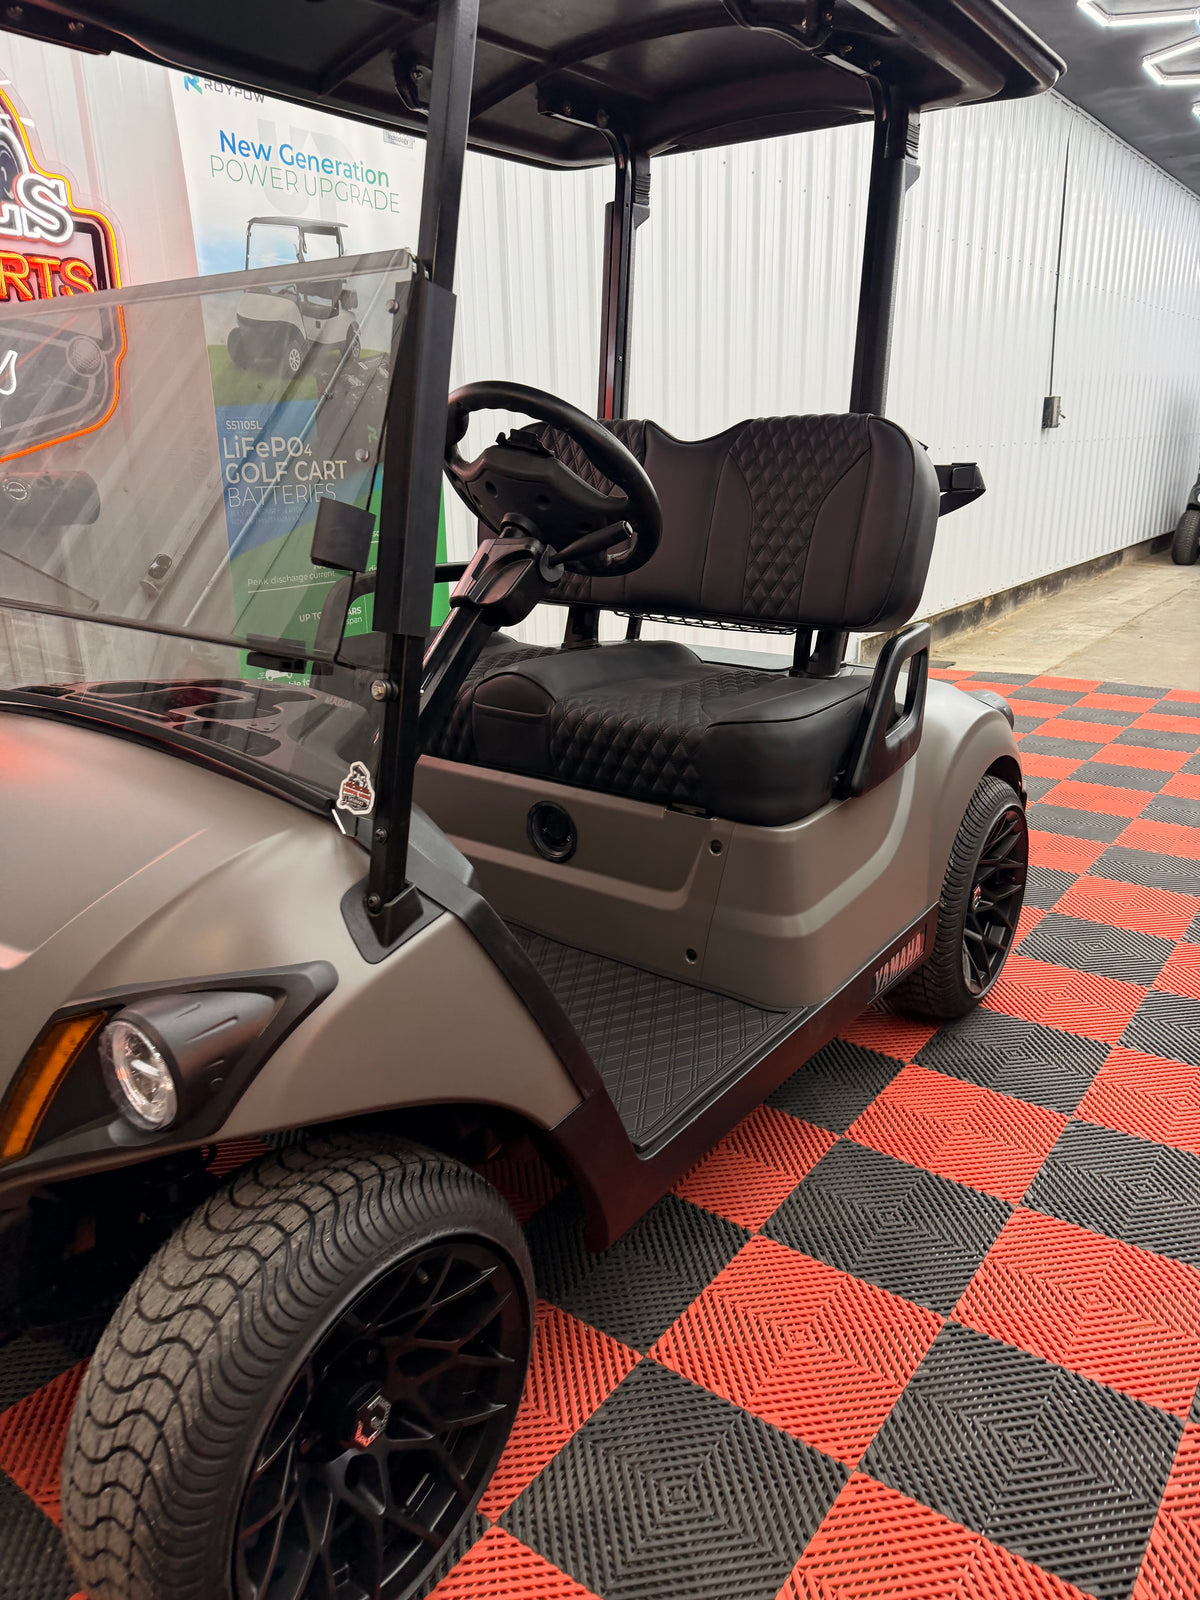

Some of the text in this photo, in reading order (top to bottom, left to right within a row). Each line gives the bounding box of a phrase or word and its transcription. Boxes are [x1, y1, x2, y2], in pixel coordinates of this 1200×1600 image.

[219, 129, 390, 188] New Generation
[210, 154, 401, 214] POWER UPGRADE
[225, 420, 263, 431] S51105L
[225, 460, 348, 485] GOLF CART
[228, 482, 337, 508] BATTERIES
[247, 569, 336, 587] Peak discharge current
[299, 613, 311, 623] UP
[875, 932, 922, 995] YAMAHA
